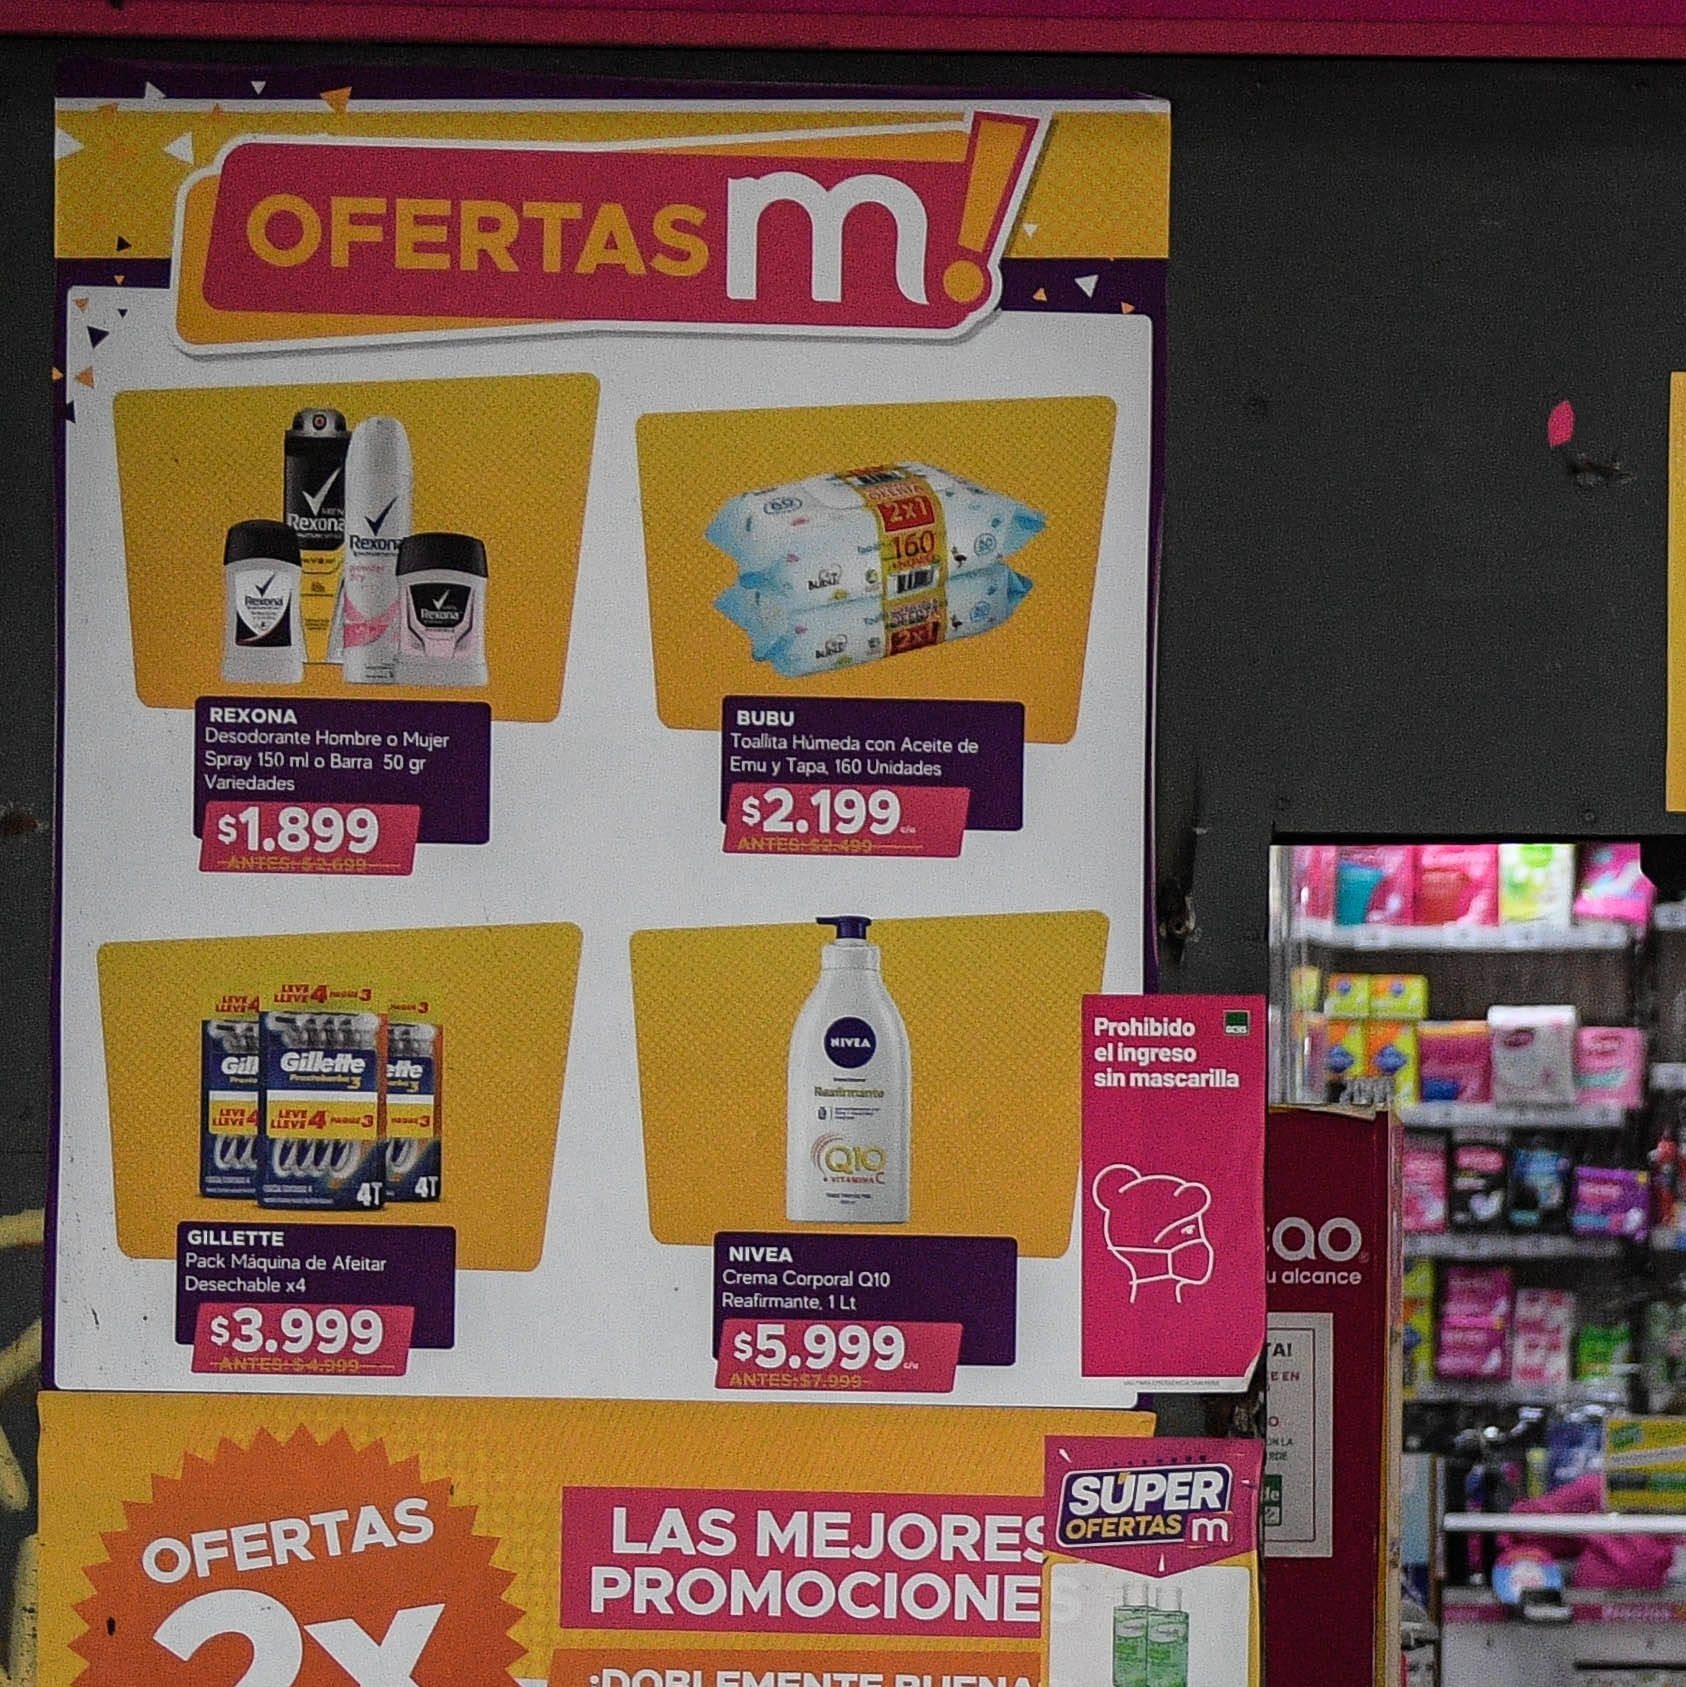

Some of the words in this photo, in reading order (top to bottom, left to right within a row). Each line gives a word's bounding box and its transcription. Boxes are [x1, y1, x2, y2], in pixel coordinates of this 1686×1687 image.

[246, 192, 710, 278] OFERTAS
[209, 707, 298, 724] REXONA
[737, 711, 795, 726] BUBU
[205, 727, 310, 745] Desodorante
[315, 730, 382, 746] Hombre
[387, 736, 397, 746] o
[403, 731, 449, 751] Mujer
[731, 733, 787, 749] Toallita
[792, 734, 860, 751] Húmeda
[865, 739, 895, 752] con
[901, 737, 952, 753] Aceite
[957, 739, 979, 753] de
[731, 757, 766, 773] Emu
[772, 762, 781, 776] y
[836, 759, 861, 774] 160
[867, 760, 942, 776] Unidades
[204, 775, 295, 791] Variedades
[742, 787, 901, 835] $2.199
[217, 806, 380, 854] $1.899
[1094, 1017, 1196, 1038] Prohibido
[831, 1036, 872, 1050] NIVEA
[280, 1050, 366, 1076] Gillette
[1095, 1043, 1113, 1062] el
[1117, 1043, 1197, 1066] ingreso
[1094, 1070, 1126, 1088] sin
[1130, 1068, 1240, 1089] mascarilla
[187, 1229, 285, 1249] GILLETTE
[185, 1252, 225, 1271] Pack
[231, 1251, 301, 1275] Máquina
[306, 1255, 327, 1271] de
[332, 1254, 387, 1273] Afeitar
[729, 1246, 793, 1263] NIVEA
[185, 1276, 280, 1295] Desechable
[286, 1278, 306, 1295] x4
[722, 1270, 778, 1288] Crema
[782, 1270, 855, 1291] Corporal
[858, 1272, 891, 1290] Q10
[1281, 1268, 1361, 1284] alcance
[209, 1306, 384, 1356] $3.999
[733, 1323, 905, 1371] $5.999
[612, 1507, 735, 1558] LAS
[1066, 1514, 1182, 1540] OFERTAS
[142, 1497, 434, 1583] OFERTAS
[590, 1567, 1041, 1622] PROMOCIONE
